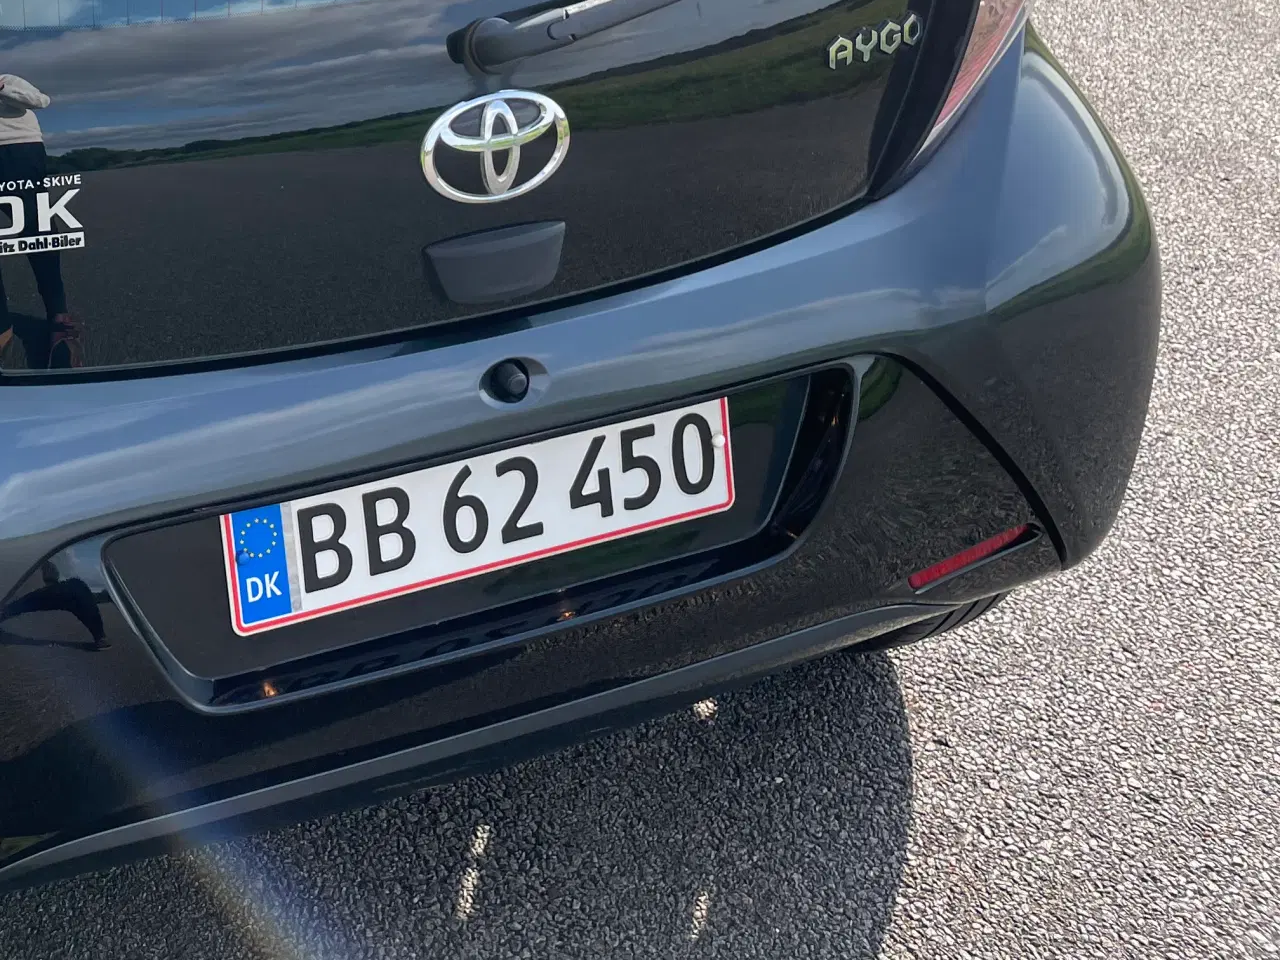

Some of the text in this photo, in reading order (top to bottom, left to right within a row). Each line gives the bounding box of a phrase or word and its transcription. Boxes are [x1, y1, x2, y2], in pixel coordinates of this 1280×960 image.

[829, 13, 921, 70] AYGO
[43, 173, 82, 188] SKIVE
[296, 412, 715, 594] BB 62 450
[246, 570, 283, 603] DK
